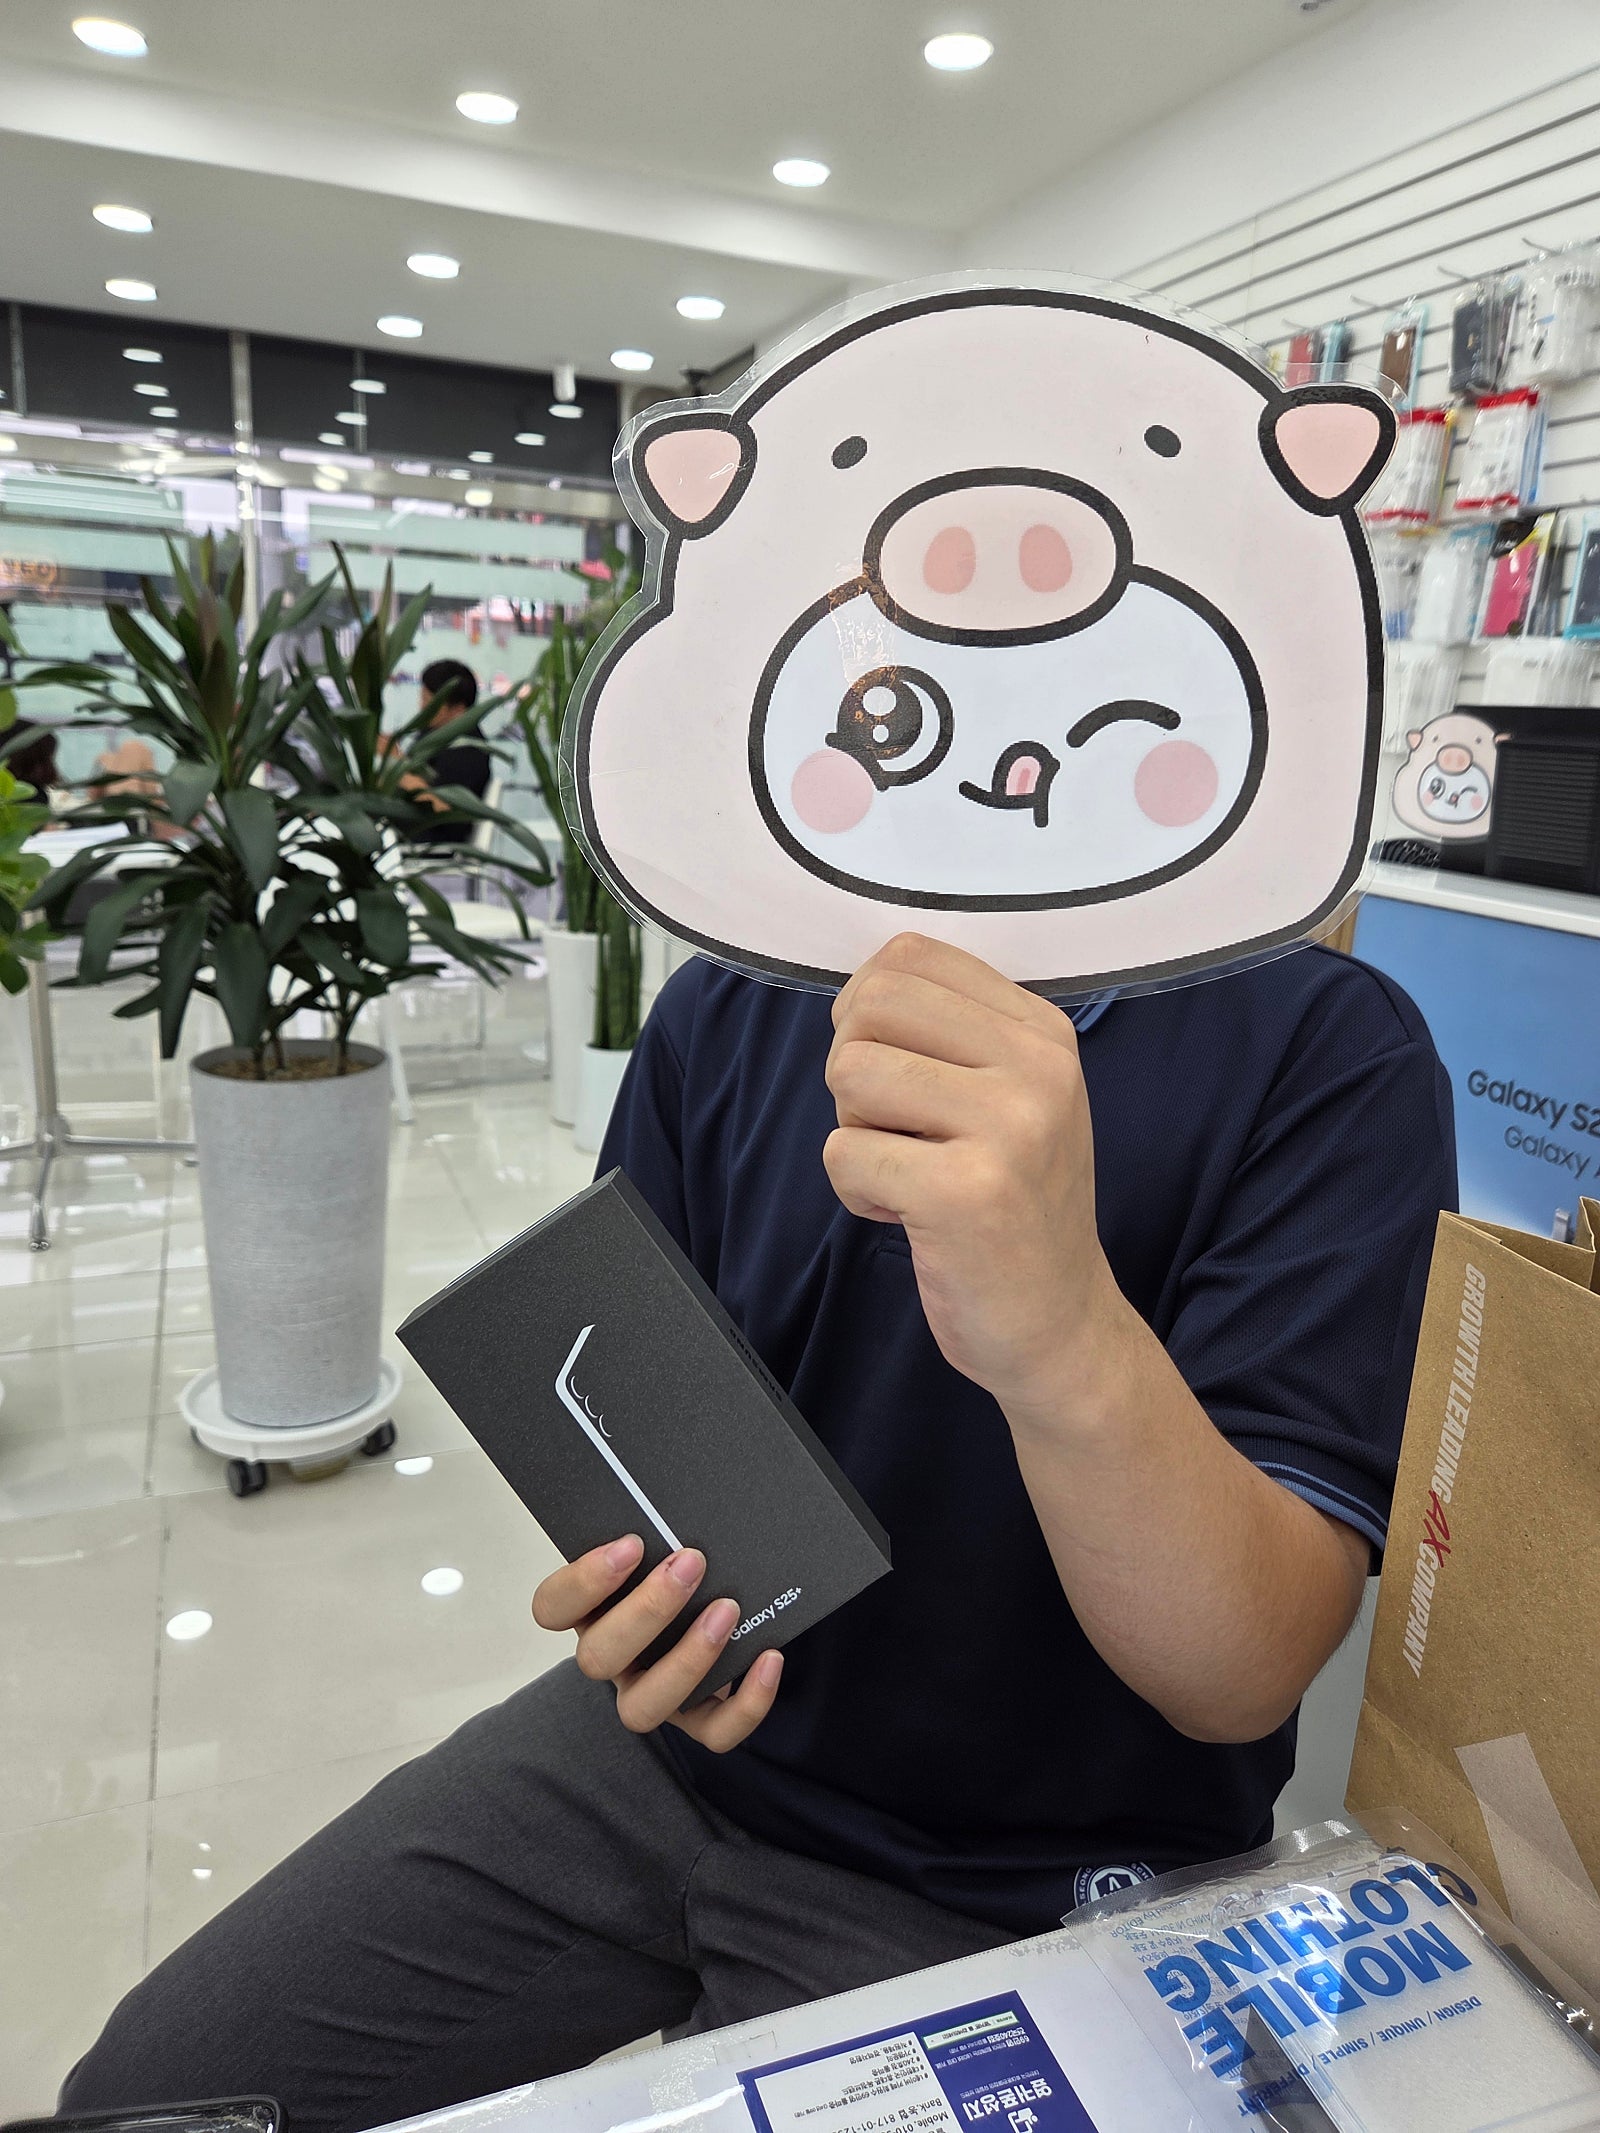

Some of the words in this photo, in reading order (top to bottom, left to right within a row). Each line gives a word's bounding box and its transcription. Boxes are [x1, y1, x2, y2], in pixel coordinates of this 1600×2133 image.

[1467, 1069, 1568, 1130] Galaxy
[1504, 1125, 1591, 1179] Galaxy
[1453, 1262, 1486, 1378] GROWTH
[1431, 1374, 1475, 1505] LEADING
[730, 1605, 775, 1640] Galaxy
[1401, 1541, 1440, 1680] COMPANY
[1108, 1915, 1144, 1938] EDITOR
[1141, 1908, 1158, 1924] by
[1182, 1921, 1472, 2078] MOBILE
[1437, 1995, 1482, 2021] DESIGN
[1005, 2035, 1030, 2048] 69만명
[1376, 2016, 1427, 2043] UNIQUE
[1318, 2038, 1369, 2065] SIMPLE
[962, 2078, 1052, 2121] 옆커폰성지
[1236, 2062, 1311, 2117] DIFFERENT
